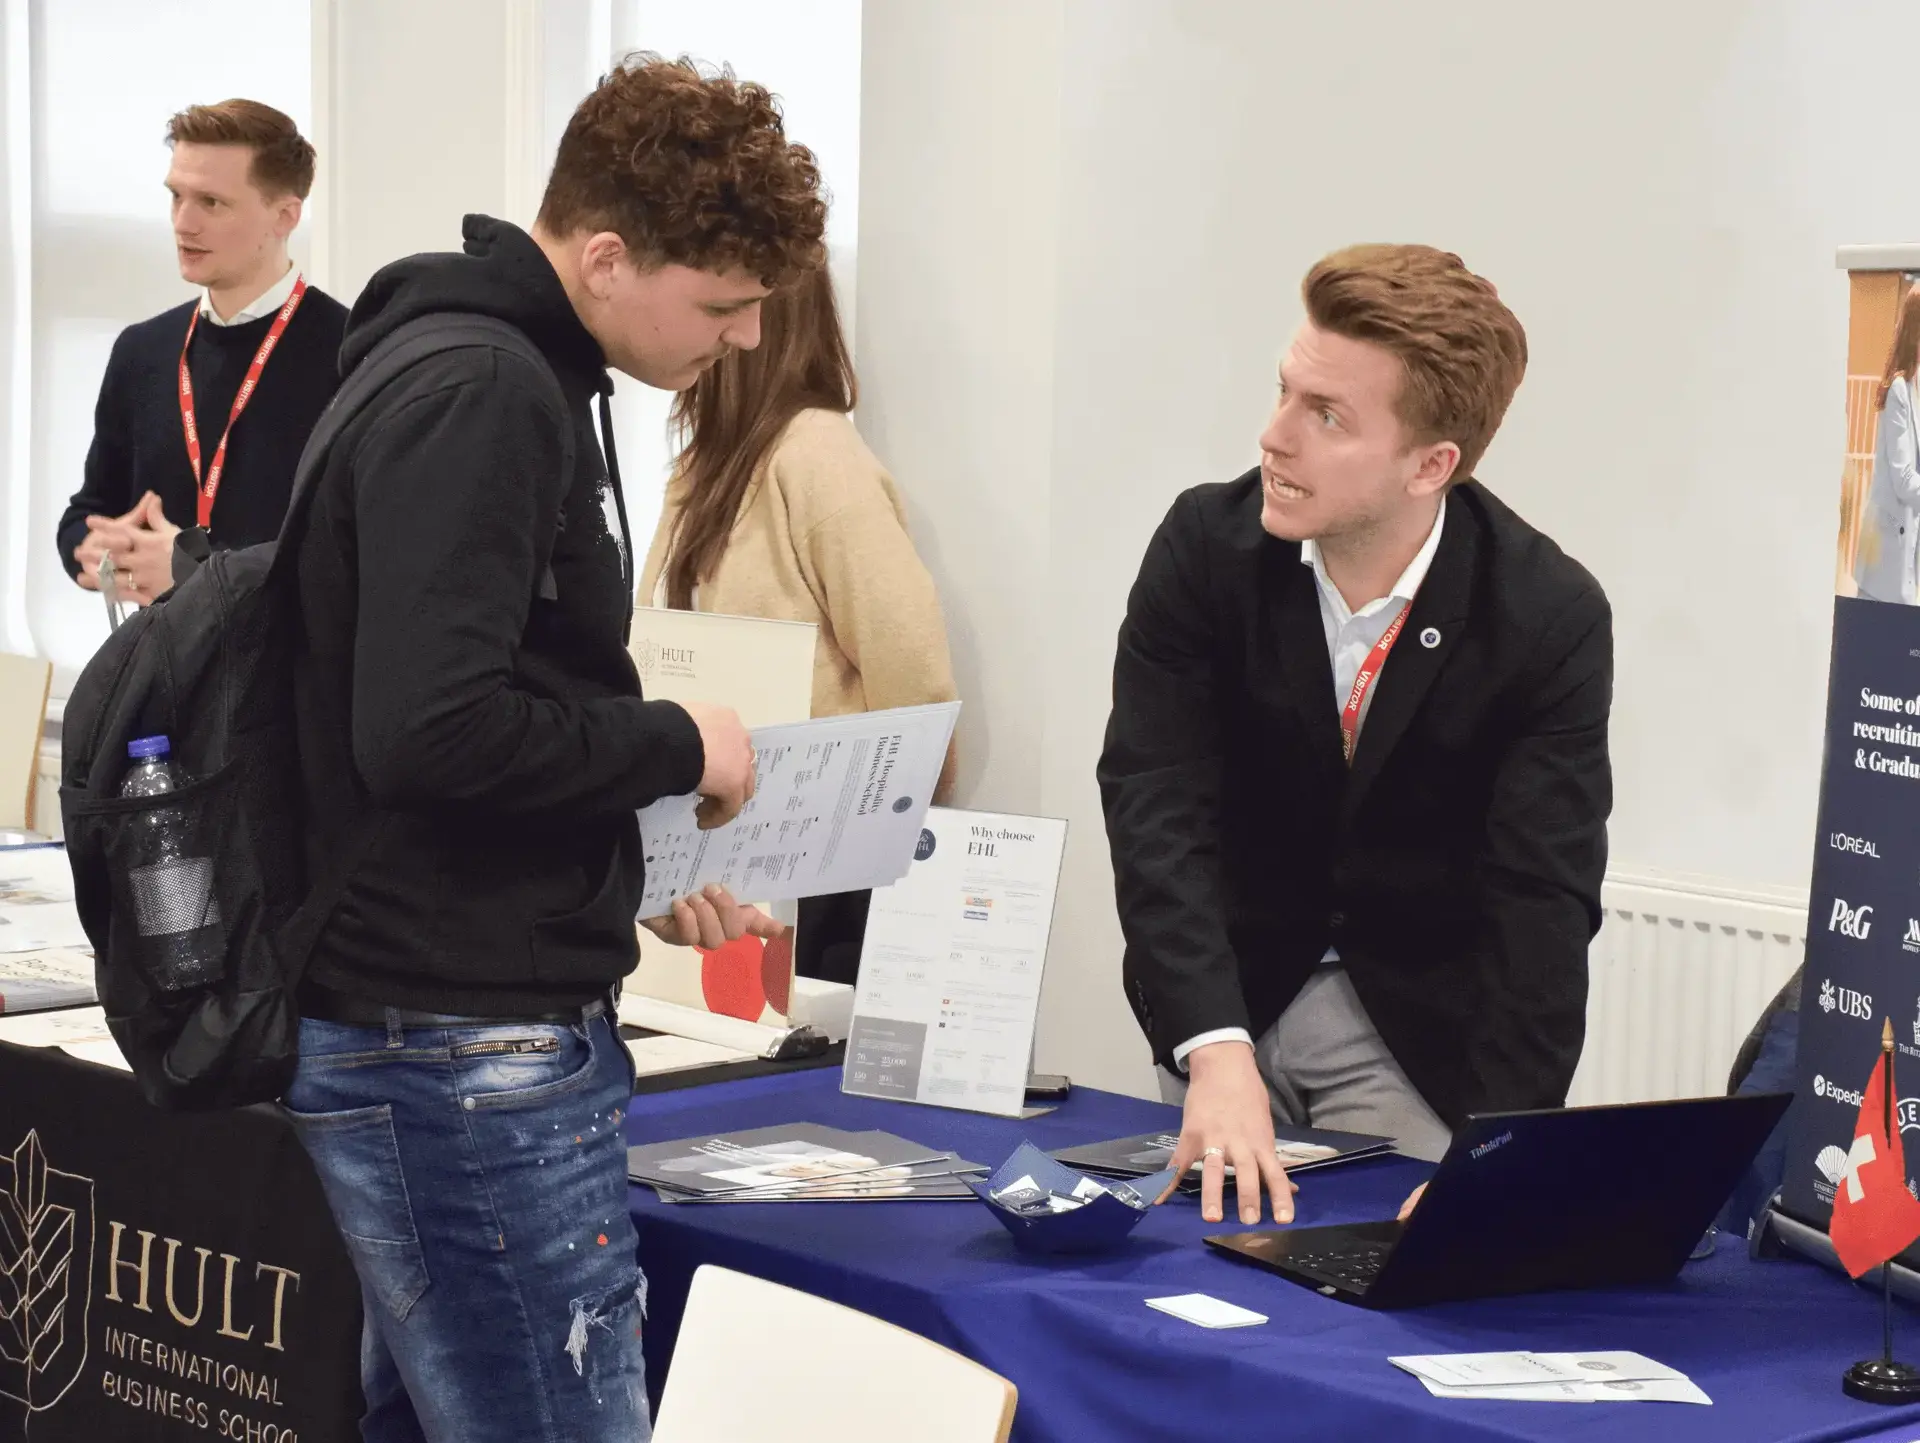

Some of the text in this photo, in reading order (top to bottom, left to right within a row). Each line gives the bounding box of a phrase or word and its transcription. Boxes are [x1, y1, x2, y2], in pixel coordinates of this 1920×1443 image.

[280, 293, 300, 322] VISITOR
[256, 335, 277, 365] VISITOR
[237, 379, 255, 410] VISITOR
[185, 410, 197, 444] VISITOR
[205, 466, 221, 498] VISITOR
[1378, 610, 1409, 651] VISITOR
[661, 647, 695, 663] HULT
[1348, 670, 1372, 712] VISITOR
[1860, 687, 1903, 713] Some
[857, 736, 889, 815] Business School
[1855, 748, 1920, 779] & Gradu
[870, 760, 895, 813] Hospitality
[967, 841, 999, 858] EHL
[970, 825, 1036, 843] Why choose
[1828, 898, 1873, 940] P&G
[1838, 987, 1872, 1020] UBS
[1470, 1130, 1512, 1160] ThinkPad
[104, 1221, 300, 1351] HULT
[105, 1326, 283, 1406] INTERNATIONAL
[103, 1371, 208, 1429] BUSINESS
